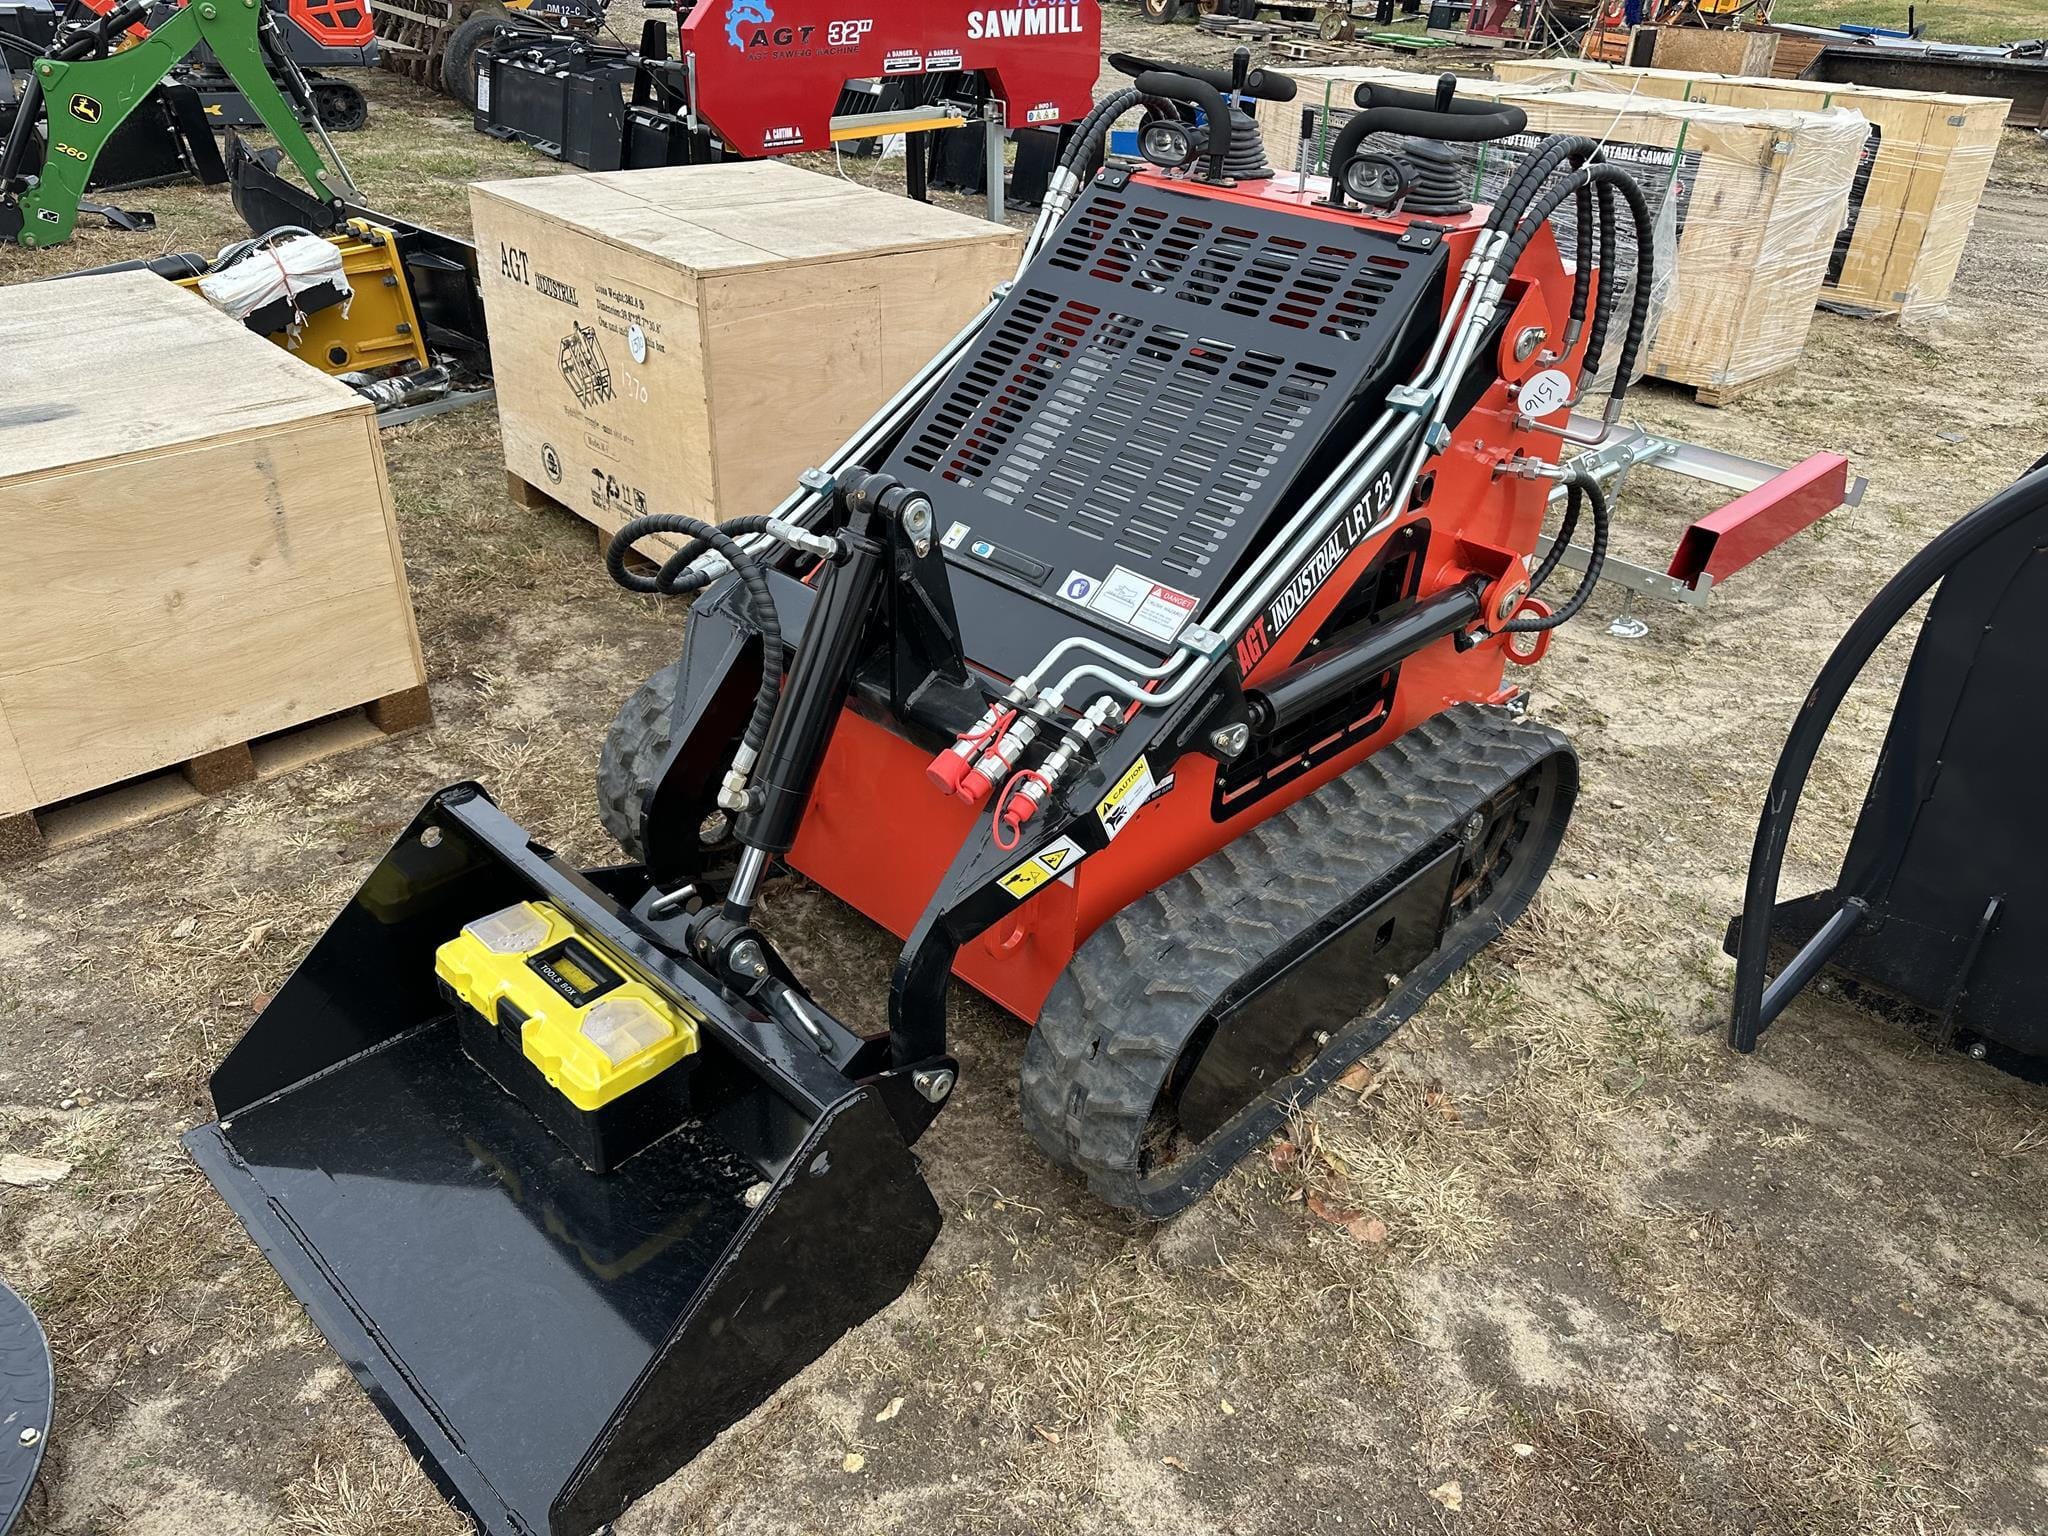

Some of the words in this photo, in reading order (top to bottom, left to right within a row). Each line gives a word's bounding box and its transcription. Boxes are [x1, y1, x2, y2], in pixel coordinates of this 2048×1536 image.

[547, 4, 560, 13] DM
[561, 5, 581, 16] 12-C
[967, 6, 1083, 39] SAWMILL
[749, 26, 815, 48] AGT
[827, 19, 873, 46] 32"
[815, 45, 860, 56] MACHINE
[891, 49, 913, 58] DANGER
[933, 49, 954, 57] DANGER
[772, 126, 793, 140] CAUTION
[55, 142, 88, 161] 260
[501, 241, 529, 286] AGT
[534, 272, 579, 308] INDUSTRIAL
[1525, 376, 1559, 411] 1516
[1345, 491, 1373, 545] LRT
[1374, 470, 1393, 513] 23
[1113, 763, 1144, 800] CAUTION
[540, 964, 562, 984] TOOLS
[560, 982, 577, 996] BOX
